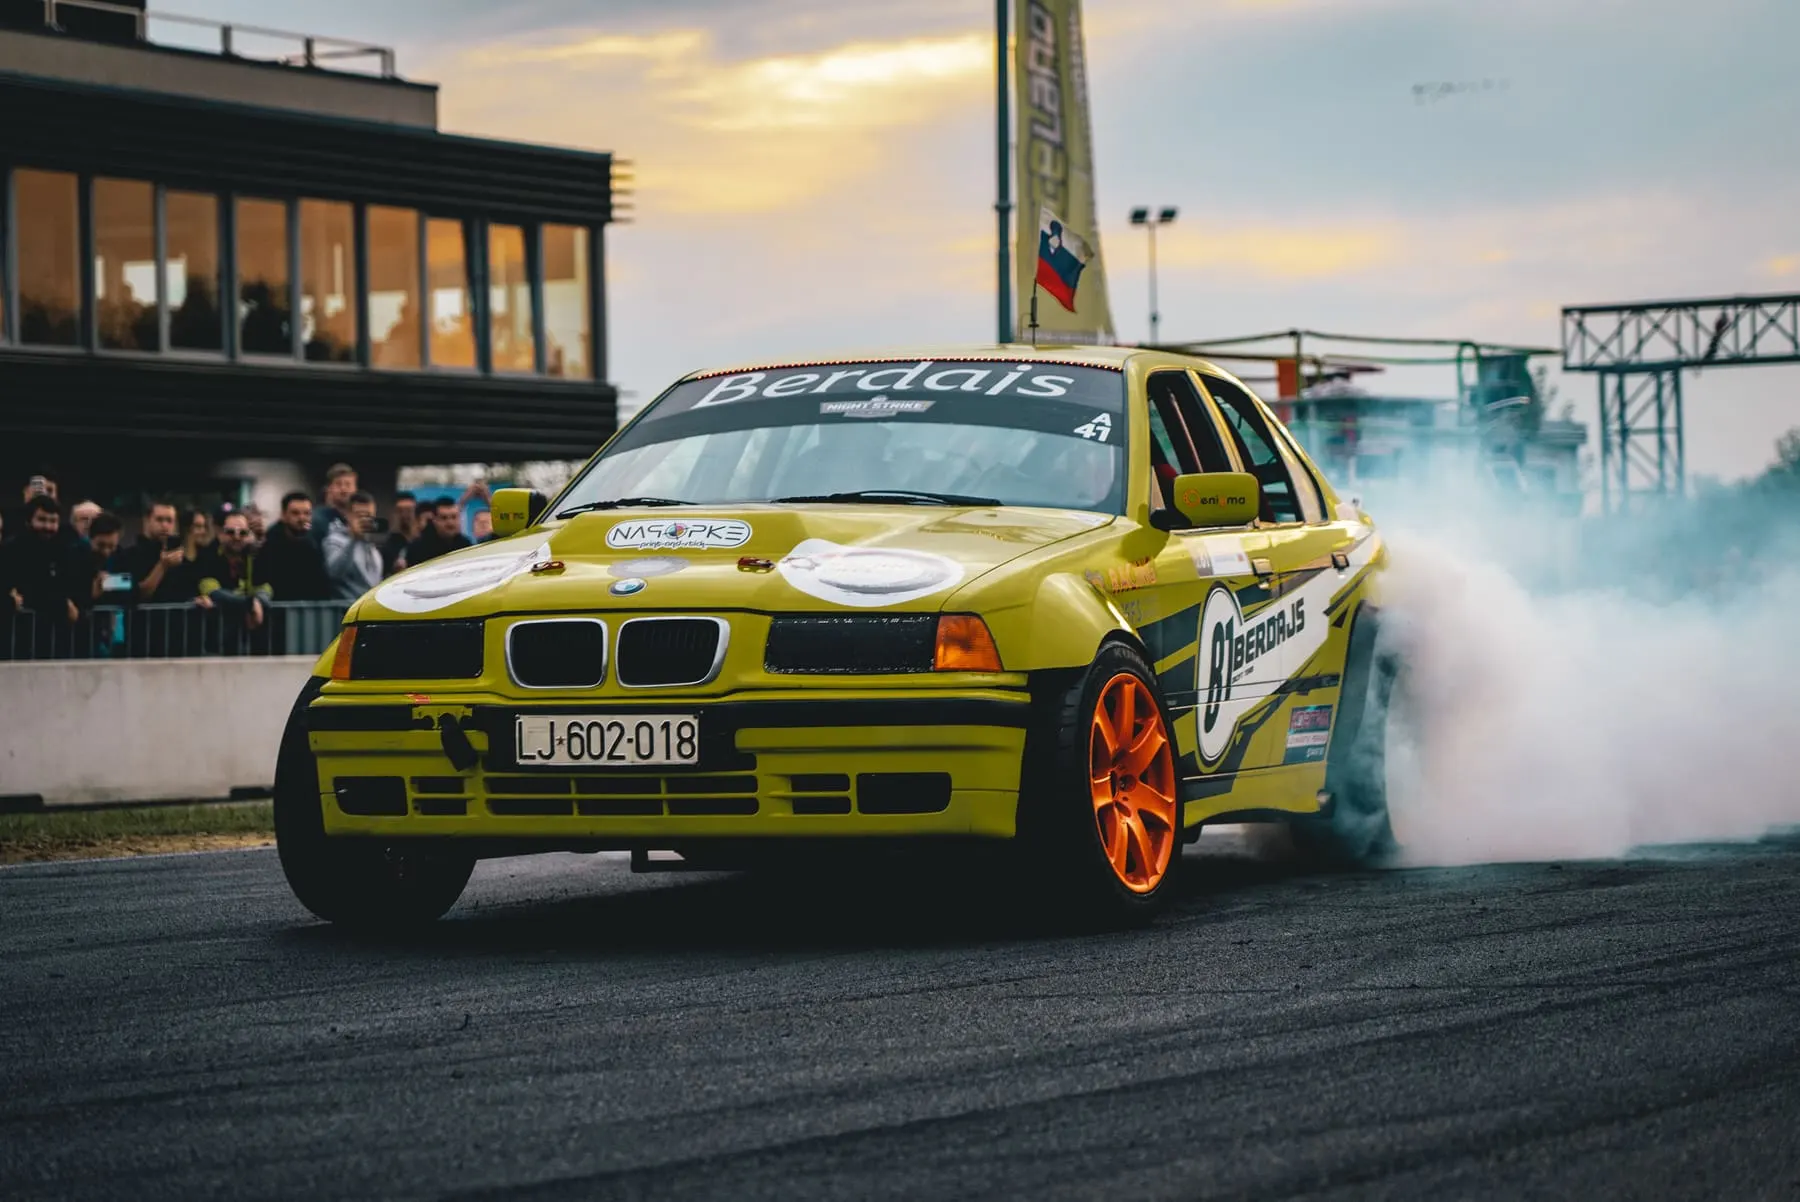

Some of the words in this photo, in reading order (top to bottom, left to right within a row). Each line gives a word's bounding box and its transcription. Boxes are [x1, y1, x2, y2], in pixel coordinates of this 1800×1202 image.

[826, 401, 868, 411] NIGHT
[1091, 412, 1112, 427] A
[1073, 424, 1112, 442] 41
[1233, 597, 1305, 672] BERDAJS
[1204, 615, 1234, 734] 81
